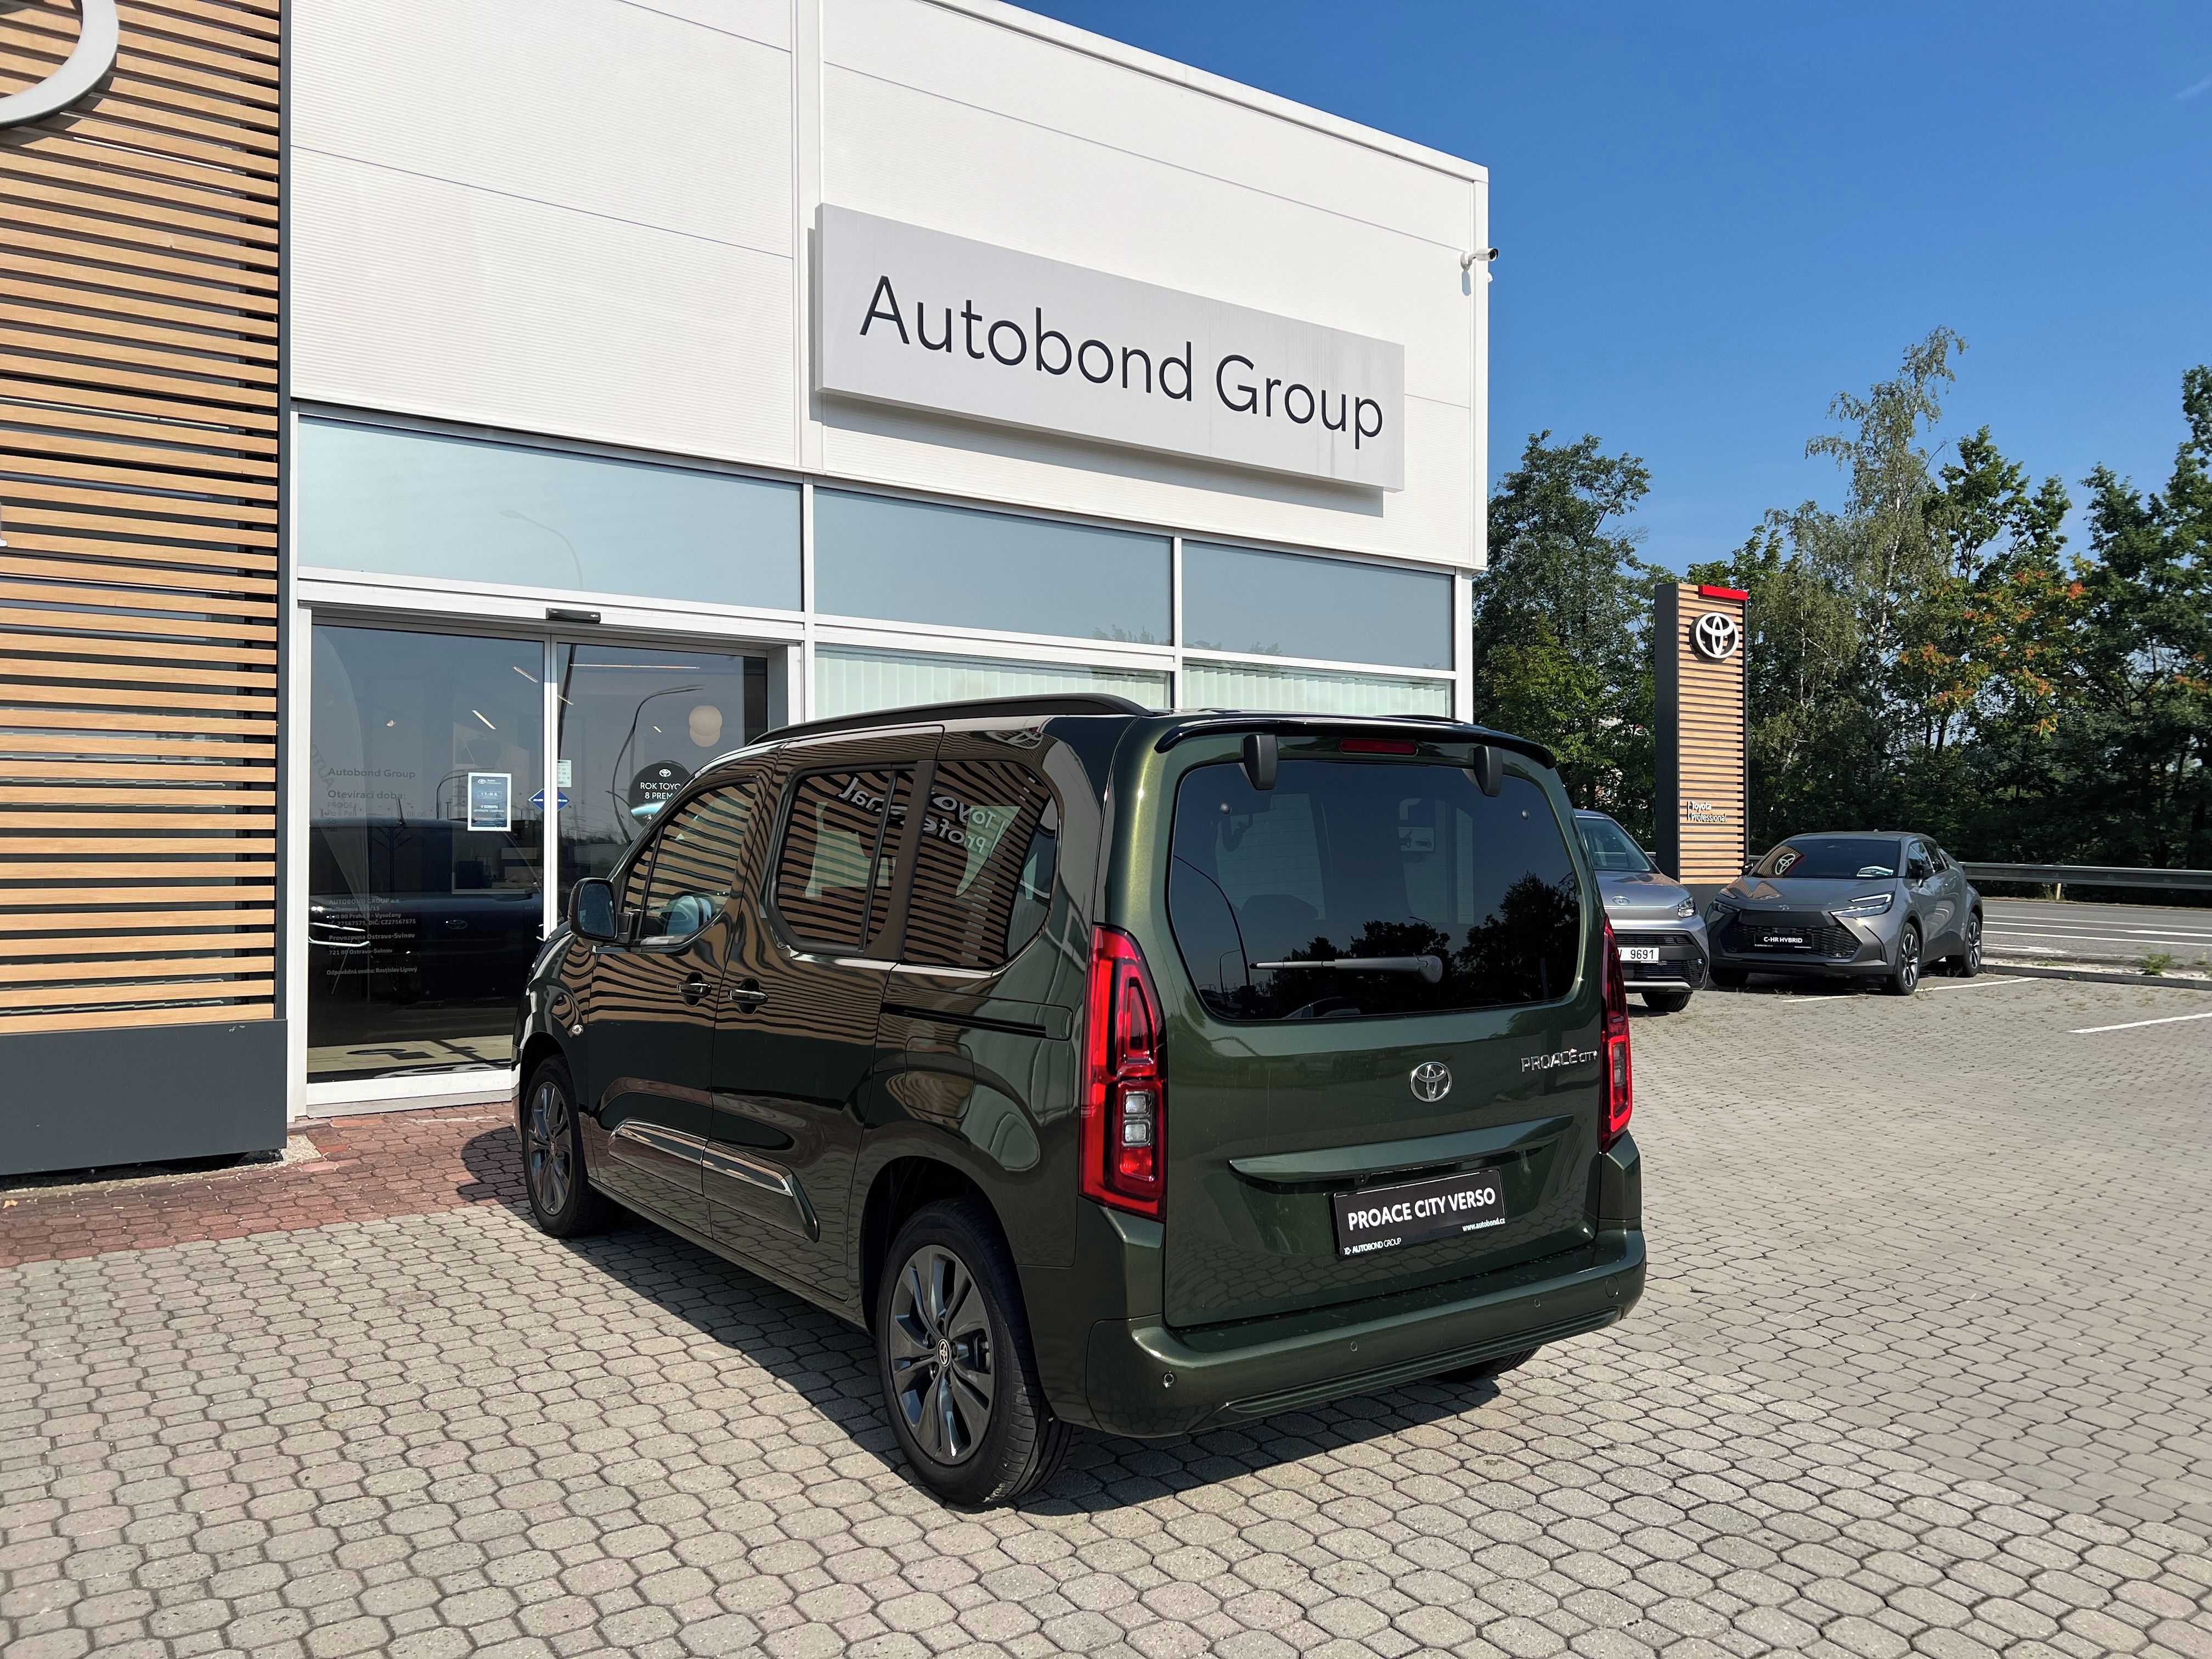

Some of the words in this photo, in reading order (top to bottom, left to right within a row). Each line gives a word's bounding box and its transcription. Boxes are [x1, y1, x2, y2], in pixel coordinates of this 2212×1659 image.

[859, 274, 1193, 402] Autobond
[1216, 354, 1383, 449] Group
[328, 768, 381, 777] Autobond
[383, 769, 416, 780] Group
[640, 782, 657, 790] ROK
[328, 790, 374, 799] Otevírací
[377, 791, 406, 799] doba:
[1691, 801, 1712, 811] Toyota
[1691, 813, 1726, 822] Professional
[366, 932, 415, 940] Ostrava-Svinov
[1630, 949, 1654, 960] 9691
[1521, 1049, 1578, 1073] PROACE
[1578, 1050, 1598, 1063] CITY
[1347, 1203, 1413, 1231] PROACE
[1414, 1196, 1446, 1218] CITY
[1447, 1187, 1496, 1212] VERSO
[1462, 1217, 1506, 1232] www.autobond.cz
[1352, 1240, 1384, 1254] AUTOBOND
[1384, 1238, 1402, 1249] GROUP
